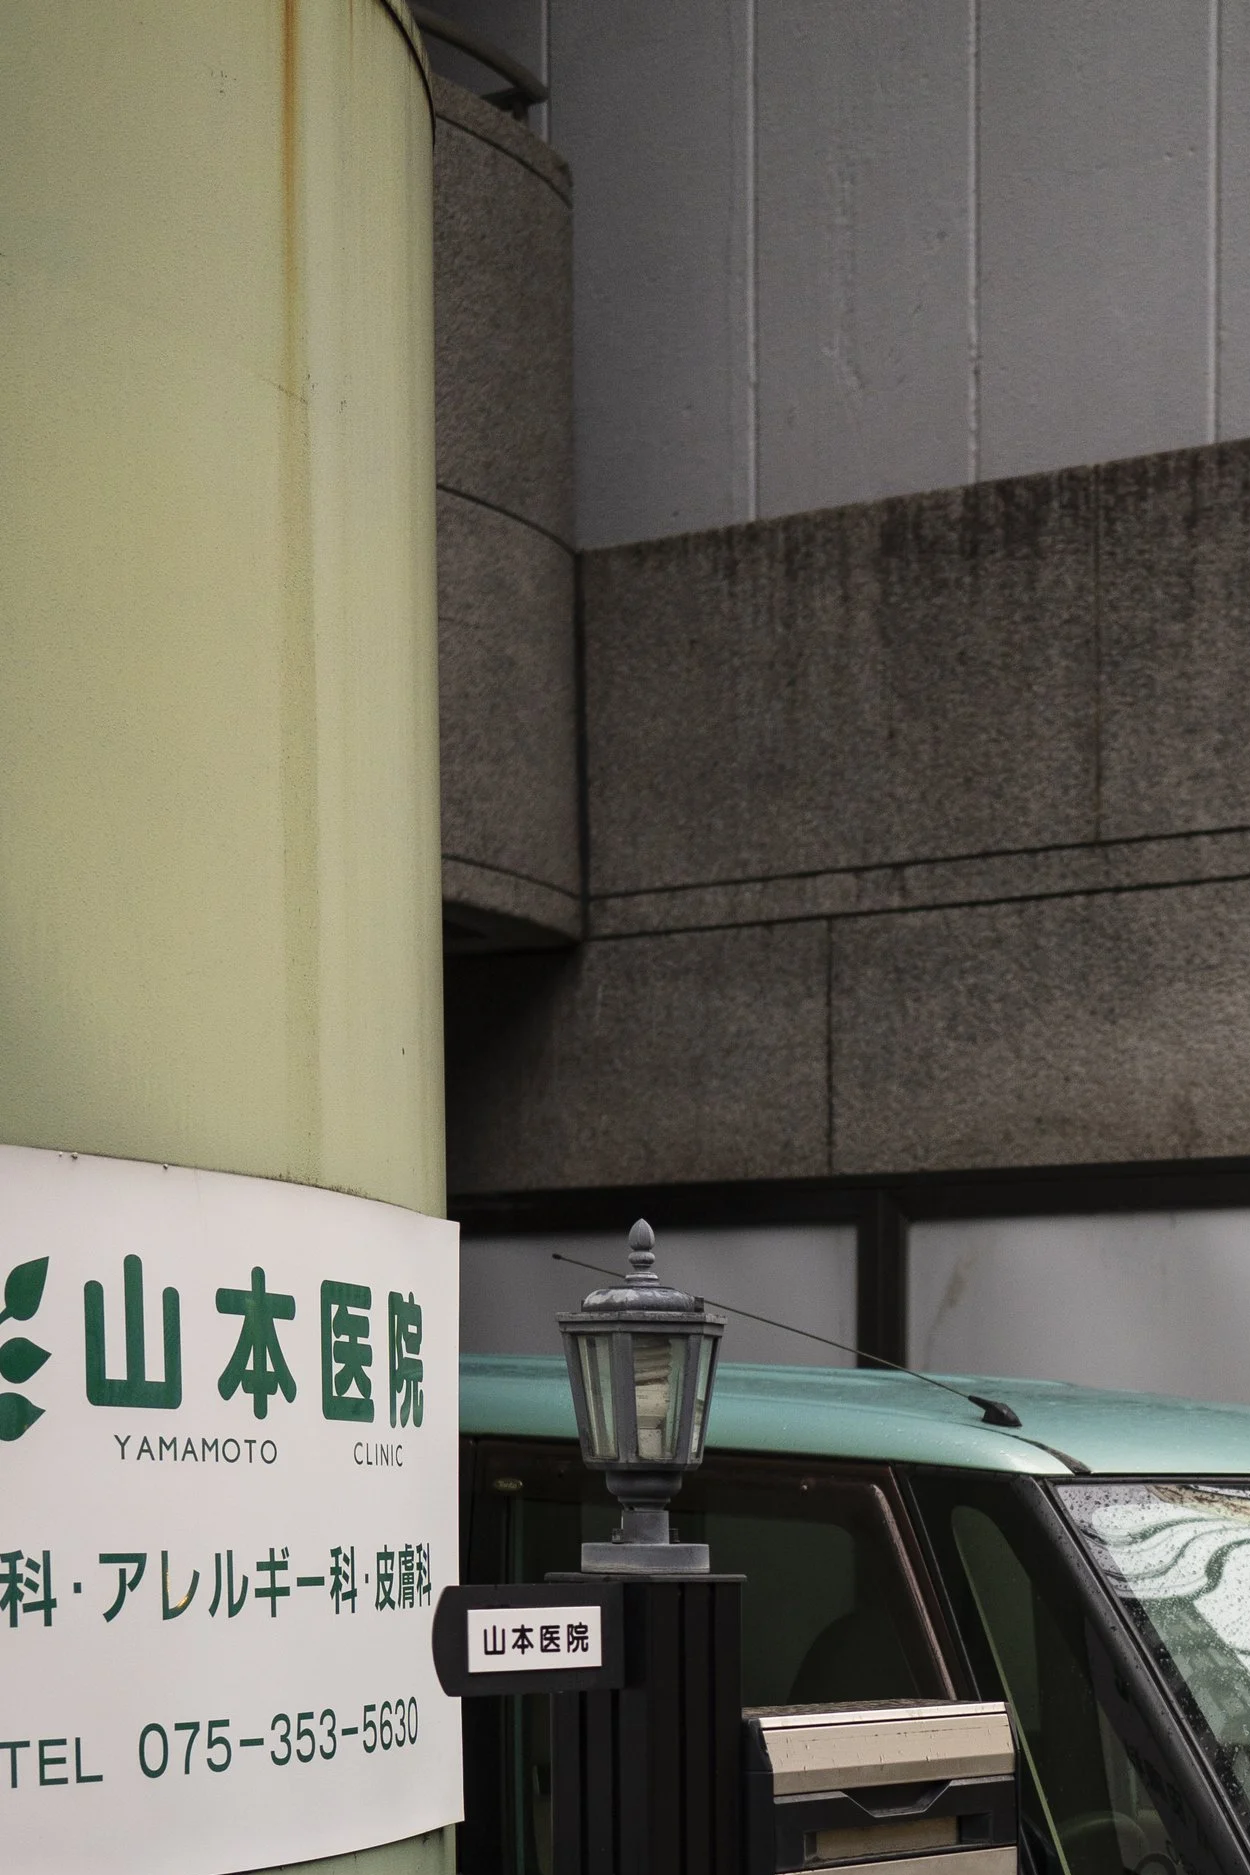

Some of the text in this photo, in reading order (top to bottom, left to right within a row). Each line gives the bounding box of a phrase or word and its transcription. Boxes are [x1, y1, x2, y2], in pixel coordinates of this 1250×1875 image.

[84, 1254, 424, 1429] 山本医院
[114, 1435, 404, 1468] YAMAMOTO CLINIC
[484, 1622, 589, 1656] 山本医院
[0, 1697, 419, 1788] TEL 075-353-5630
